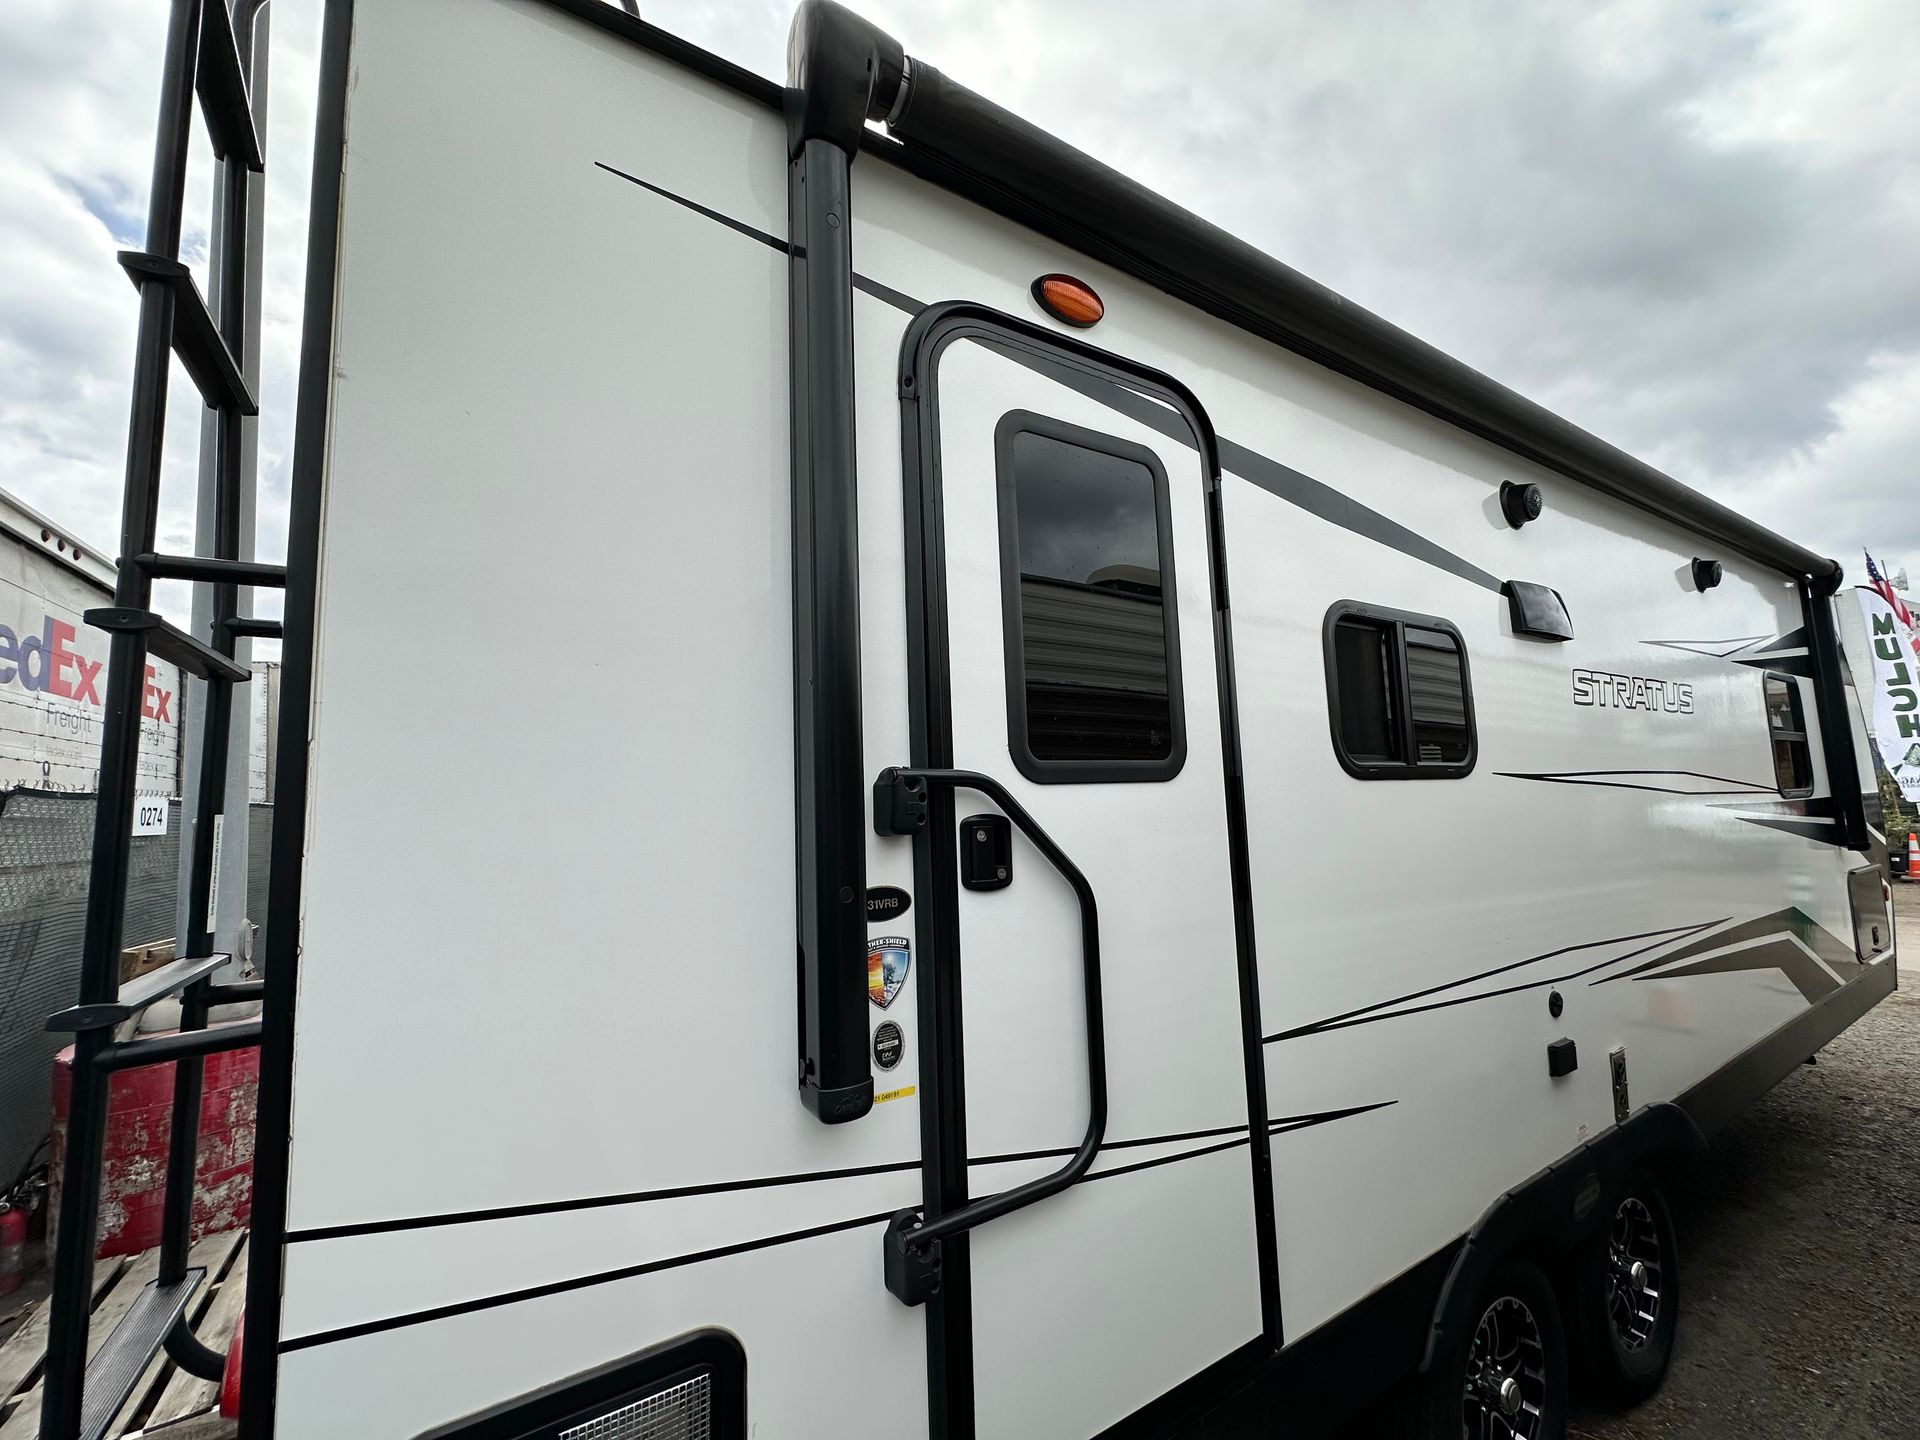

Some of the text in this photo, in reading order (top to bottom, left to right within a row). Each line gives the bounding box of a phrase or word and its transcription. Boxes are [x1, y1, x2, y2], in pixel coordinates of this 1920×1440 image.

[1572, 668, 1694, 714] STRATUS
[47, 702, 91, 734] Freight
[140, 807, 163, 826] 0274
[867, 897, 899, 910] 31VRB
